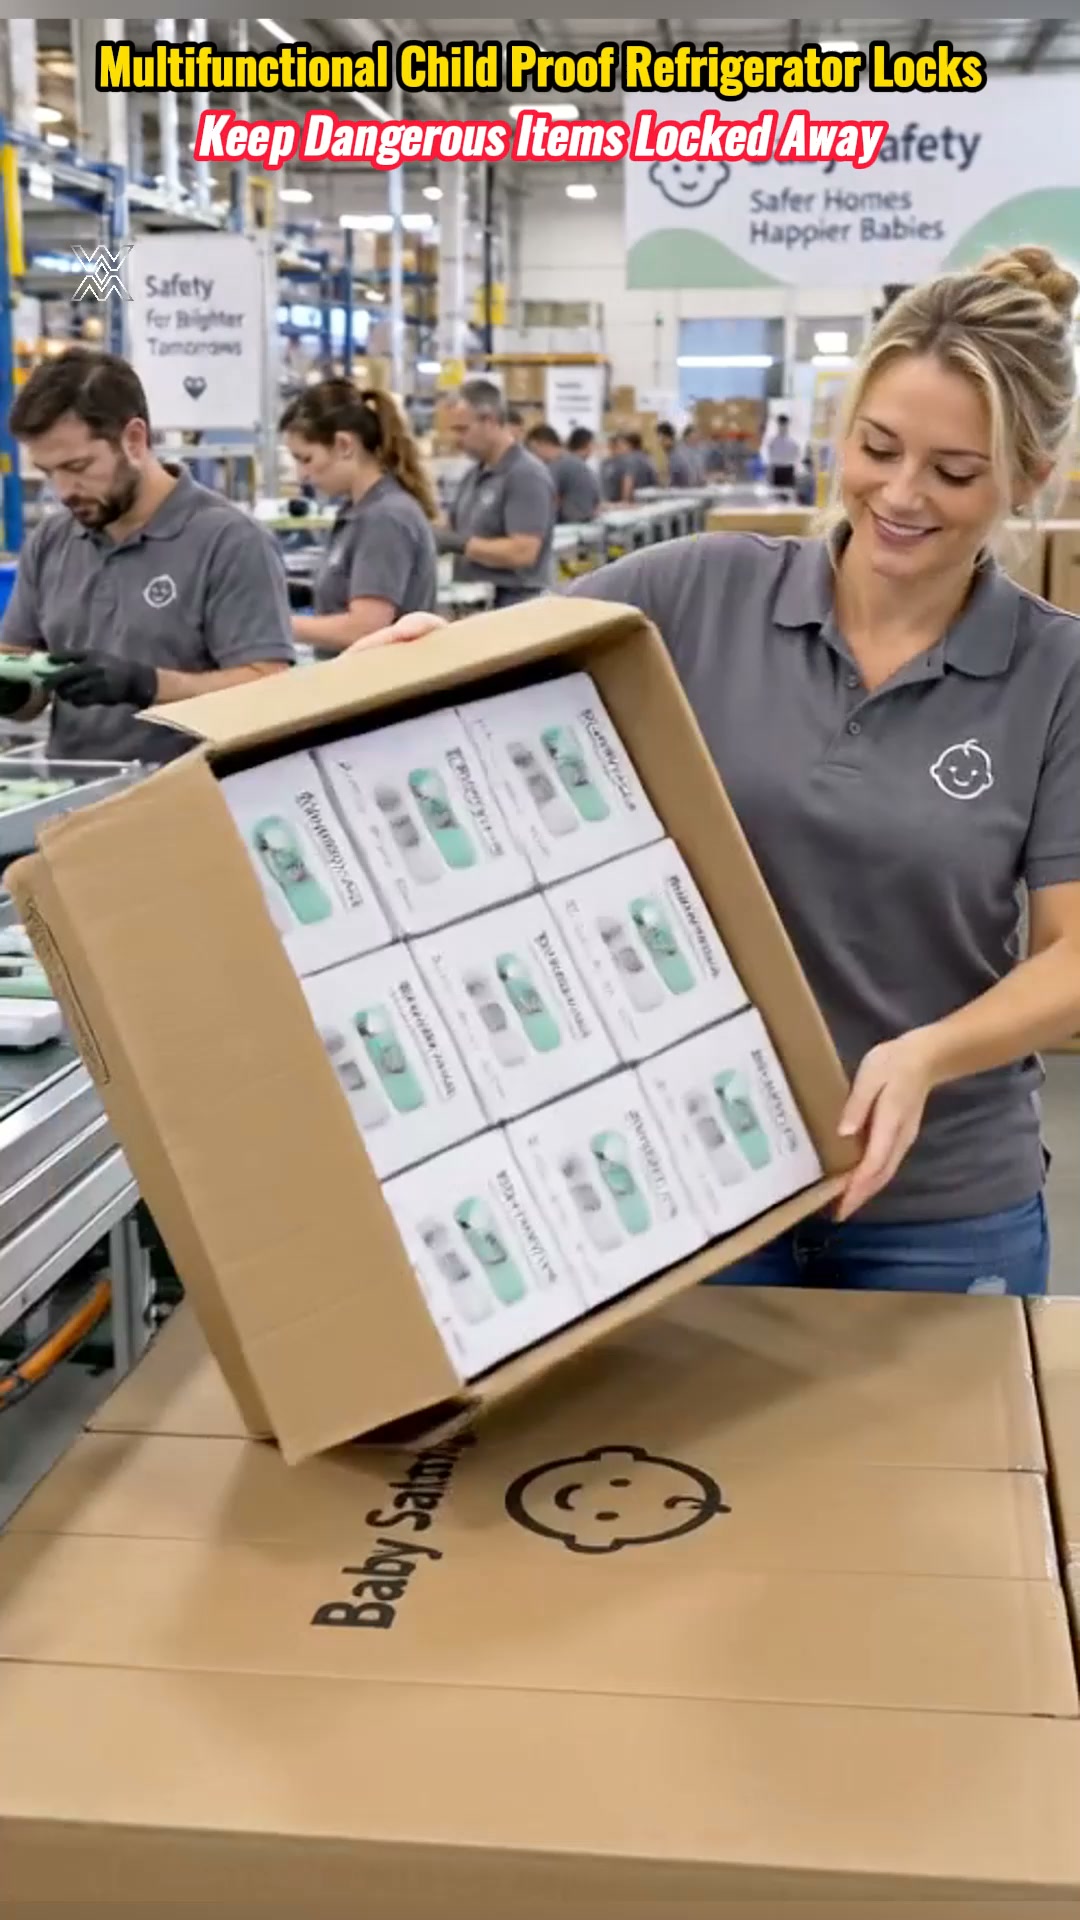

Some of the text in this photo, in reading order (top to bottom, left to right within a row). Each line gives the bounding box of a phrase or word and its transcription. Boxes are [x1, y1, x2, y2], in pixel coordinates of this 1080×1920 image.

[877, 122, 981, 171] afety
[750, 187, 912, 213] Safer Homes
[750, 216, 945, 250] Happier Babies
[145, 272, 214, 301] Safety
[310, 1537, 443, 1629] Baby
